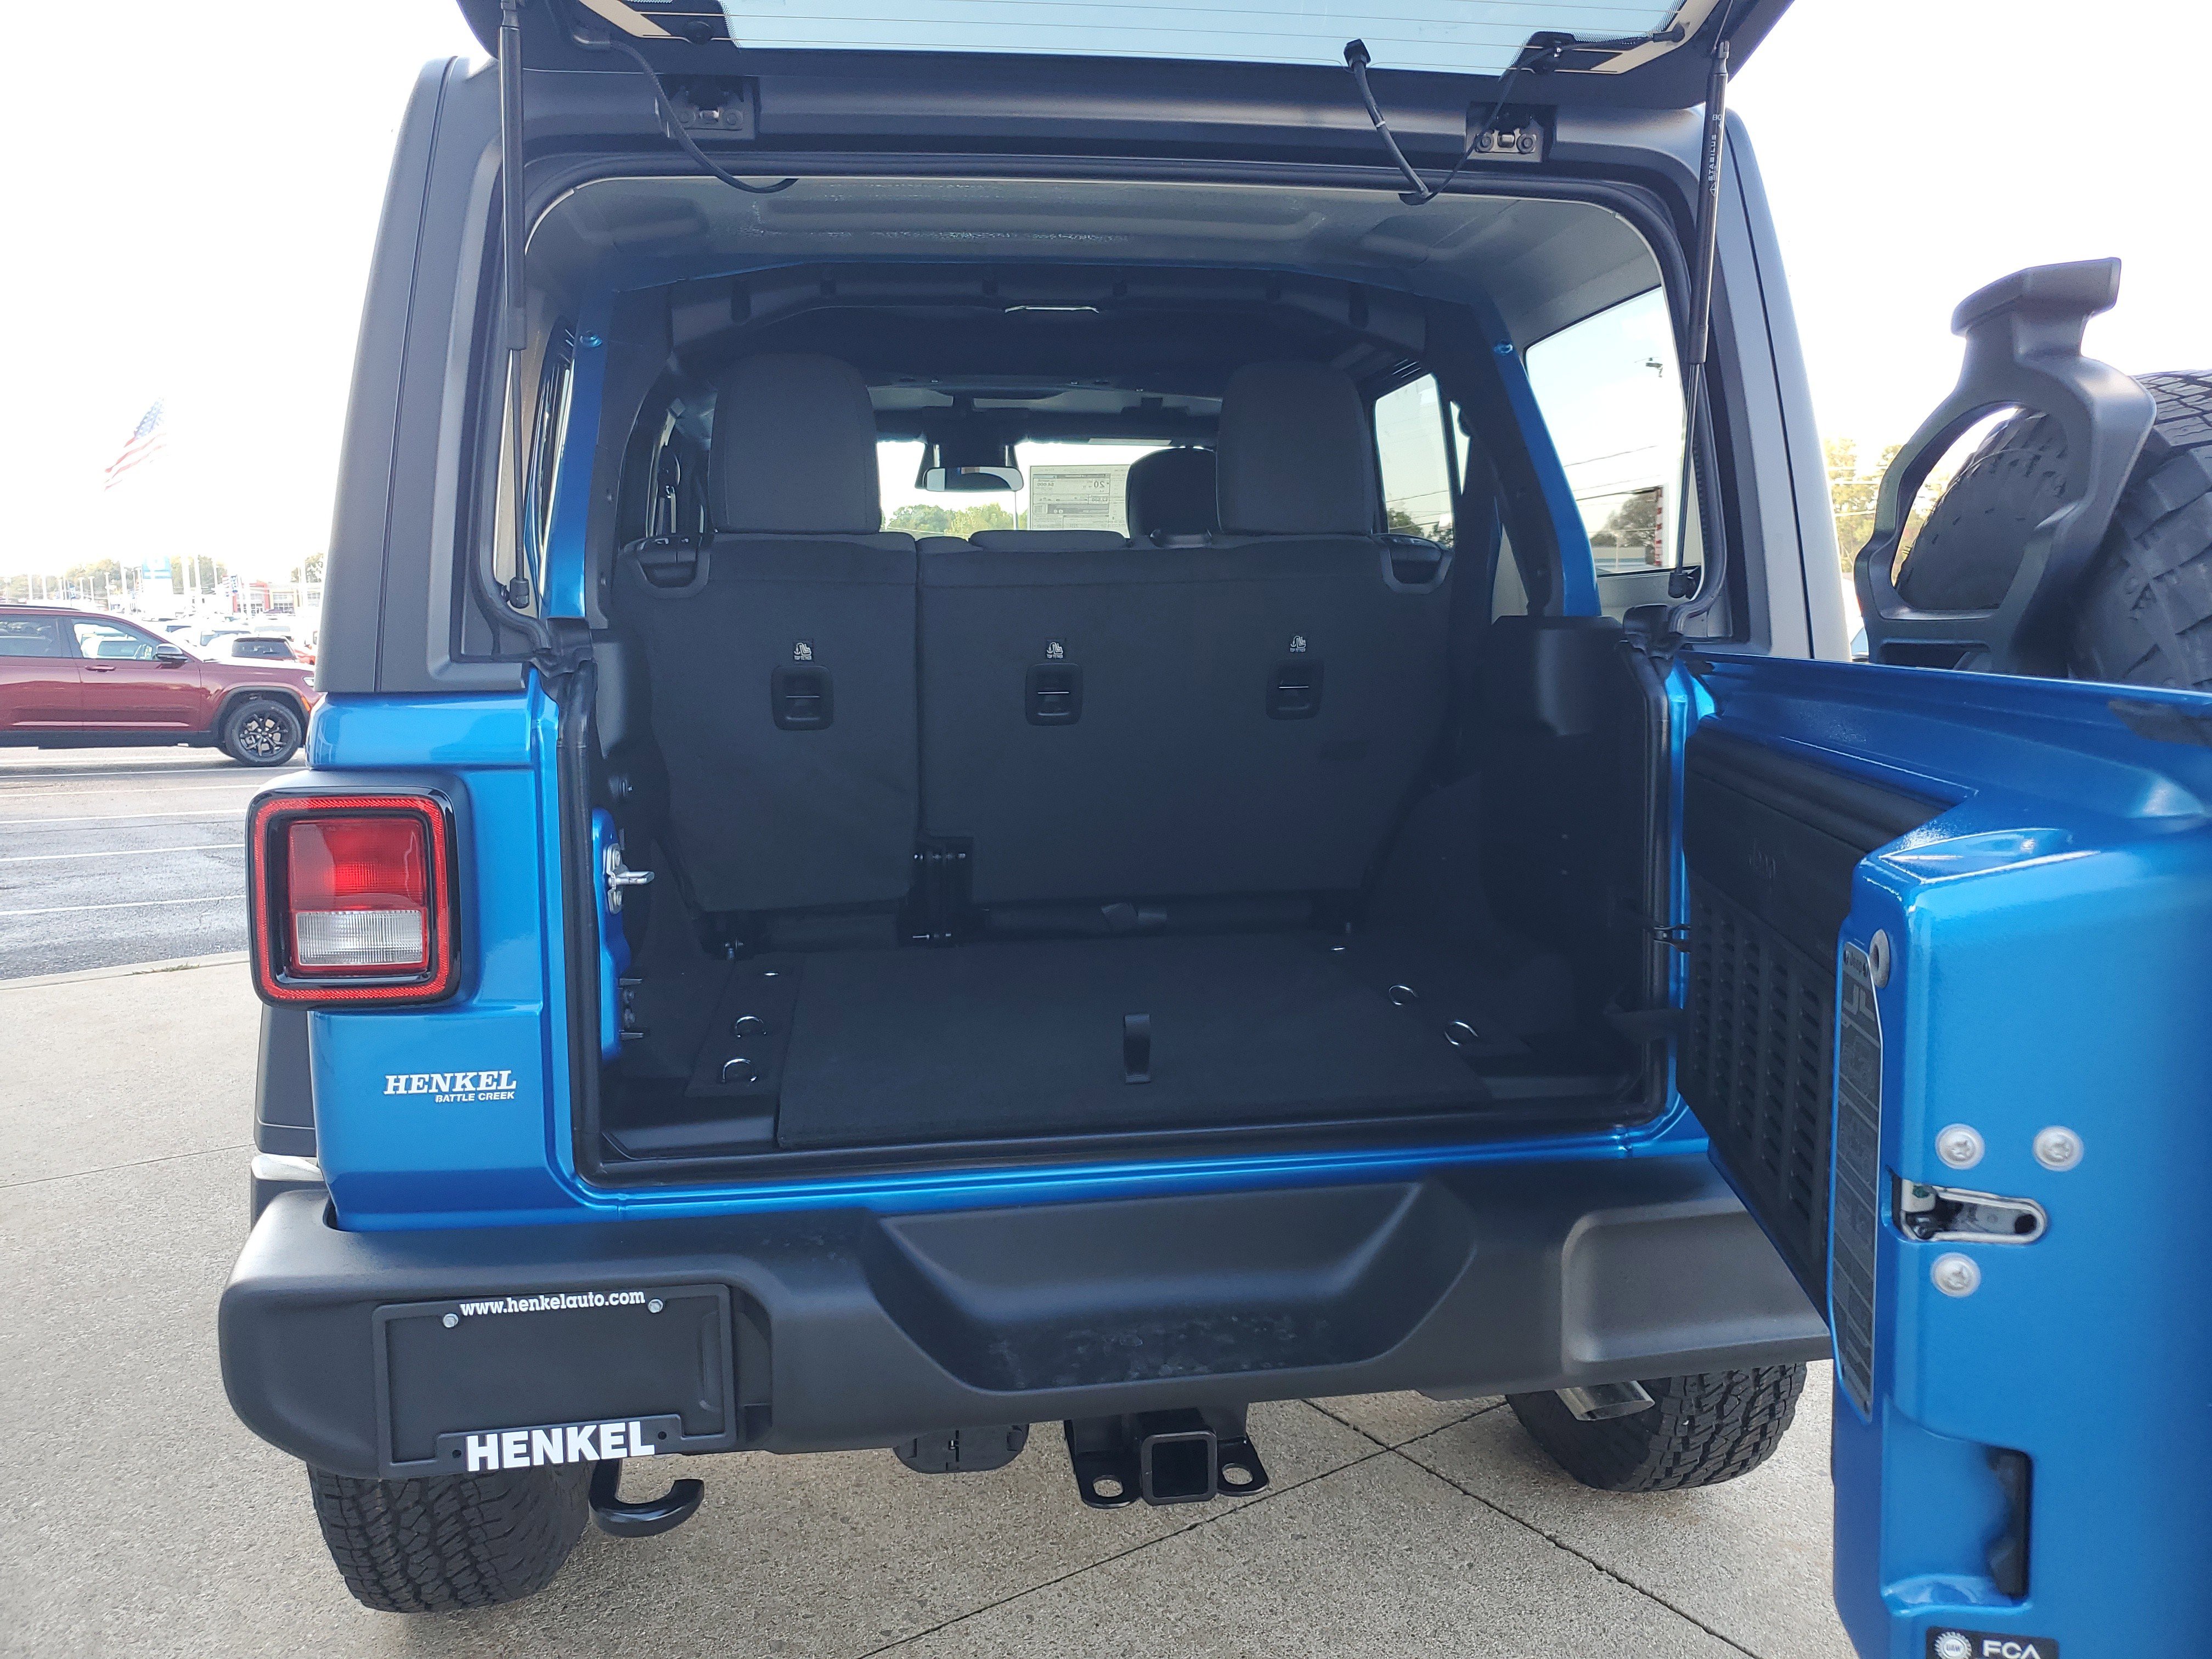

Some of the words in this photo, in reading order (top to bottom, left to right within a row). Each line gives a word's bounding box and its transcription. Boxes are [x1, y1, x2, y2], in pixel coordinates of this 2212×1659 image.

[1708, 134, 1717, 182] STABILUS
[383, 1070, 517, 1094] HENKEL
[435, 1093, 476, 1103] BATTLE
[478, 1091, 515, 1101] CREEK
[460, 1291, 646, 1316] www.henkelauto.com
[466, 1421, 656, 1472] HENKEL
[1983, 1639, 2041, 1659] FCA
